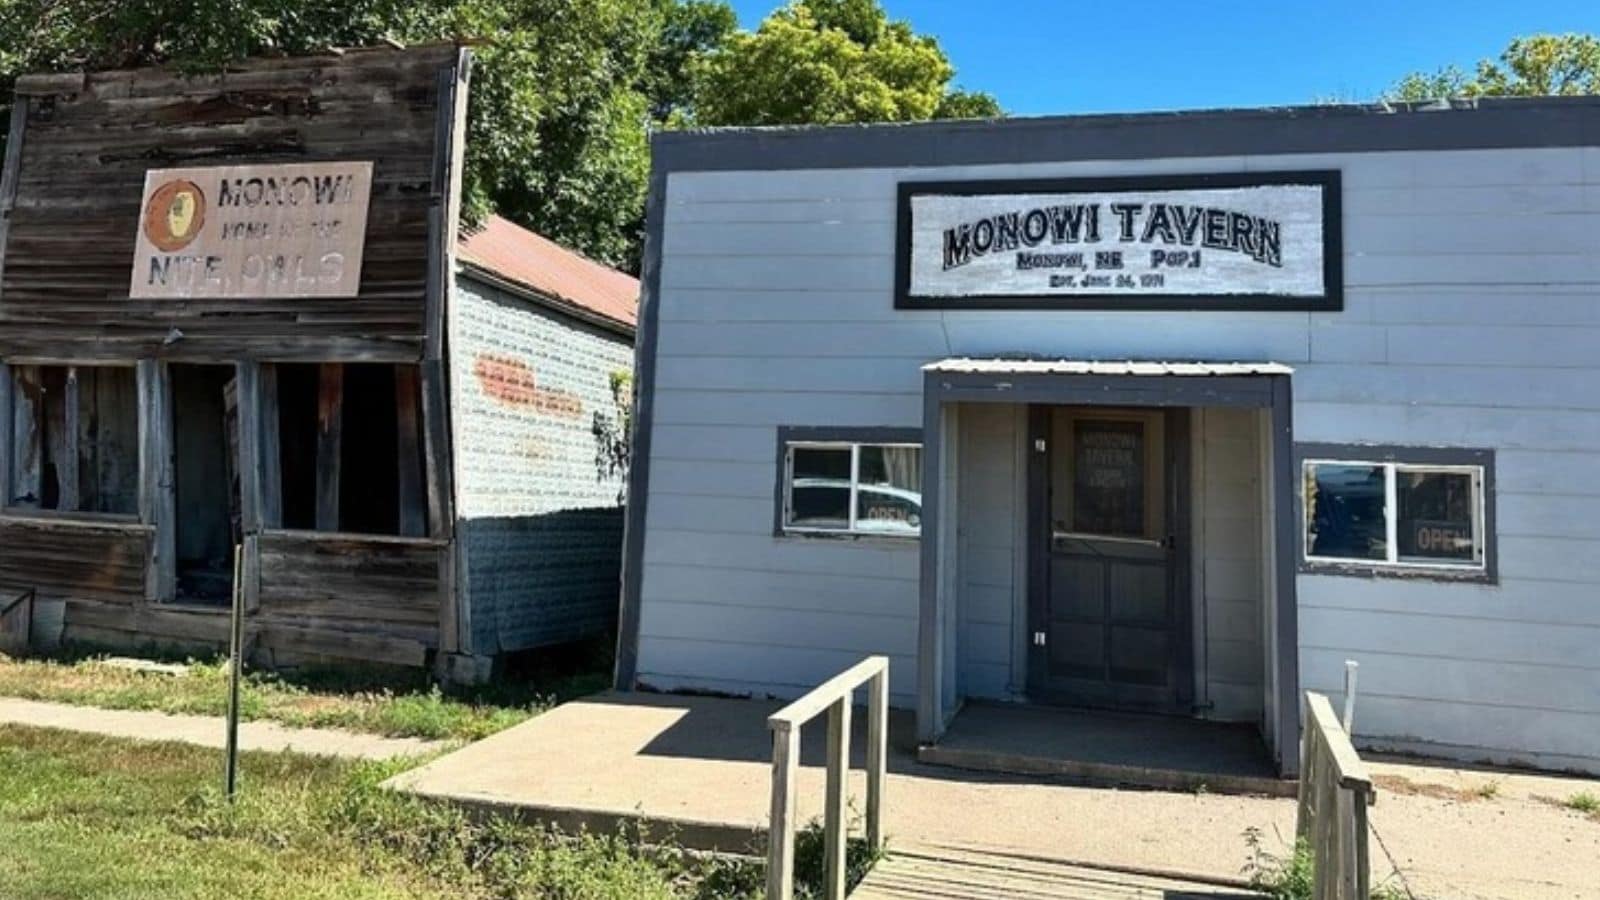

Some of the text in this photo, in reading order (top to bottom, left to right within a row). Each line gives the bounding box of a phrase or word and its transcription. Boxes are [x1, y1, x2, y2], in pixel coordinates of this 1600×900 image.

[217, 174, 353, 207] MONOWI
[942, 202, 1283, 271] MONOWI TAVERN
[1095, 251, 1125, 270] NE
[1417, 527, 1468, 552] OPEN
